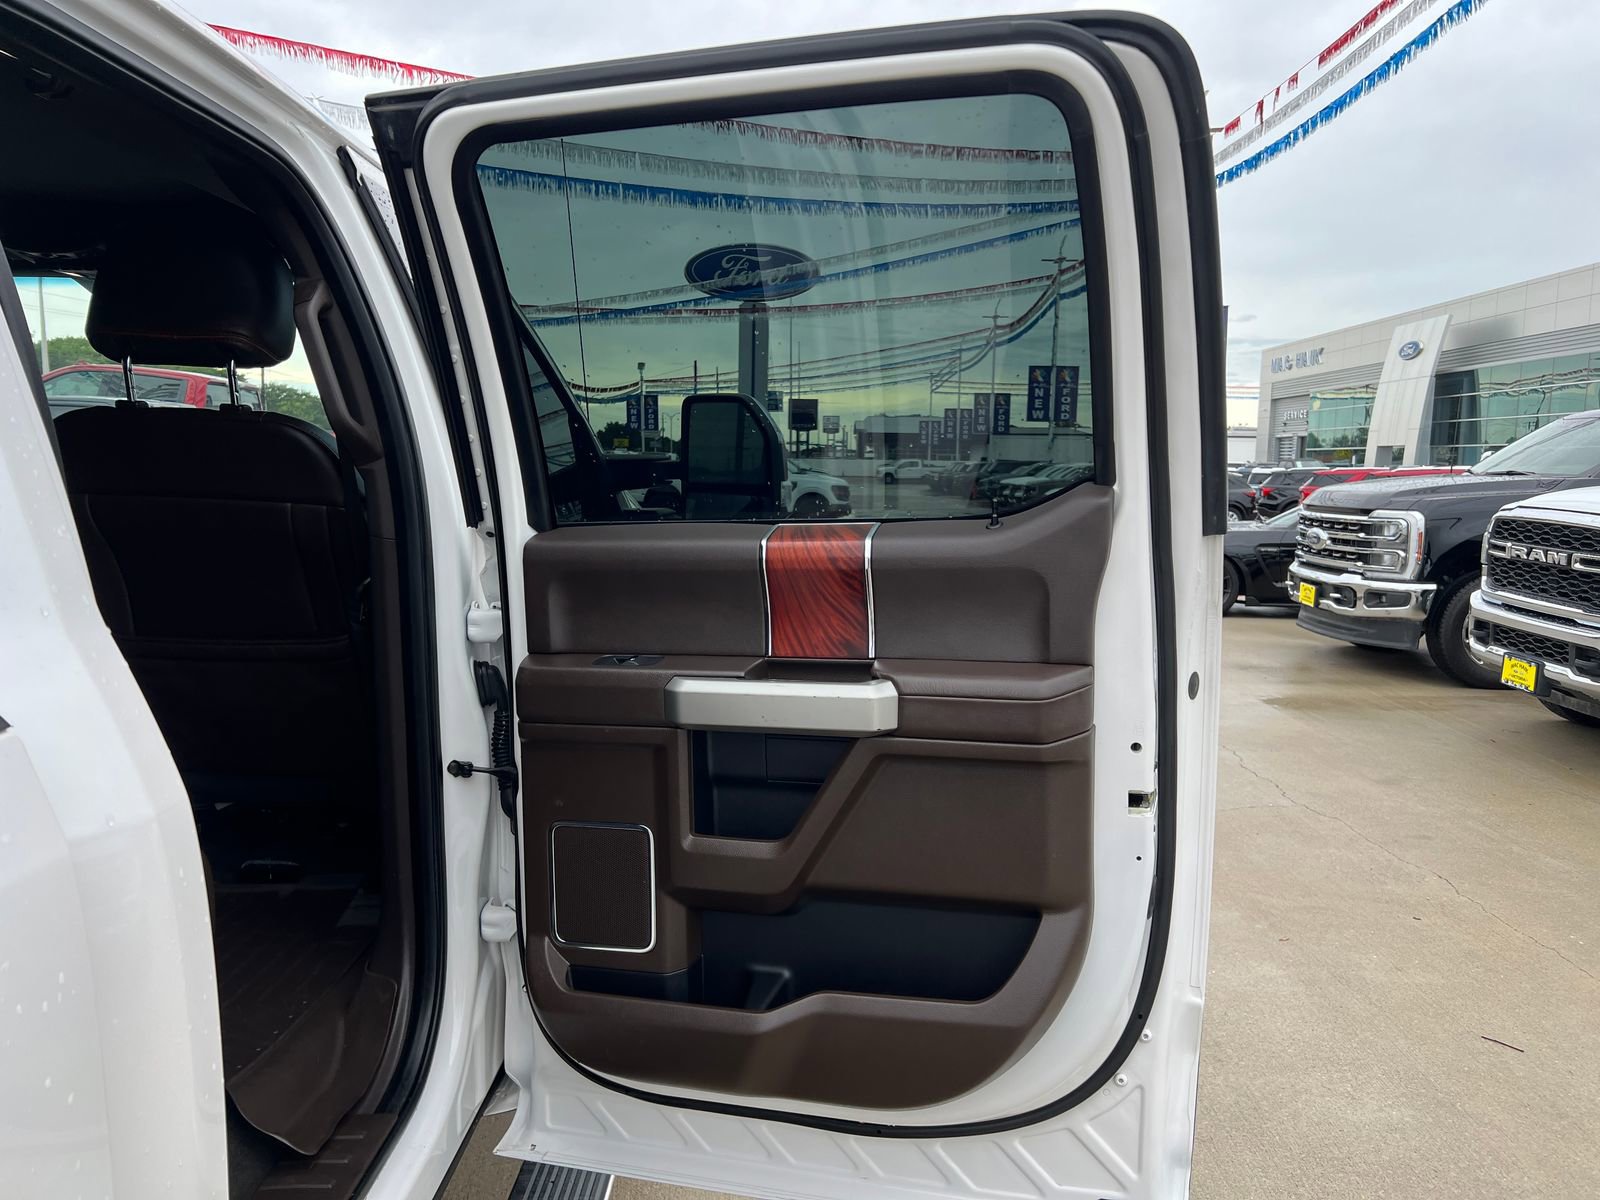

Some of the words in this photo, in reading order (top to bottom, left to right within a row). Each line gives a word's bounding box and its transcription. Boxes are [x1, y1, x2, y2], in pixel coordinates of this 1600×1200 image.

[713, 253, 793, 287] Ford
[1031, 388, 1045, 419] NEW
[1060, 388, 1071, 420] FORD
[1283, 409, 1307, 420] SERVICE
[630, 408, 639, 429] NEW
[647, 408, 655, 430] FORD
[976, 409, 986, 431] NEW
[997, 408, 1006, 432] FORD
[1511, 545, 1567, 566] RAM
